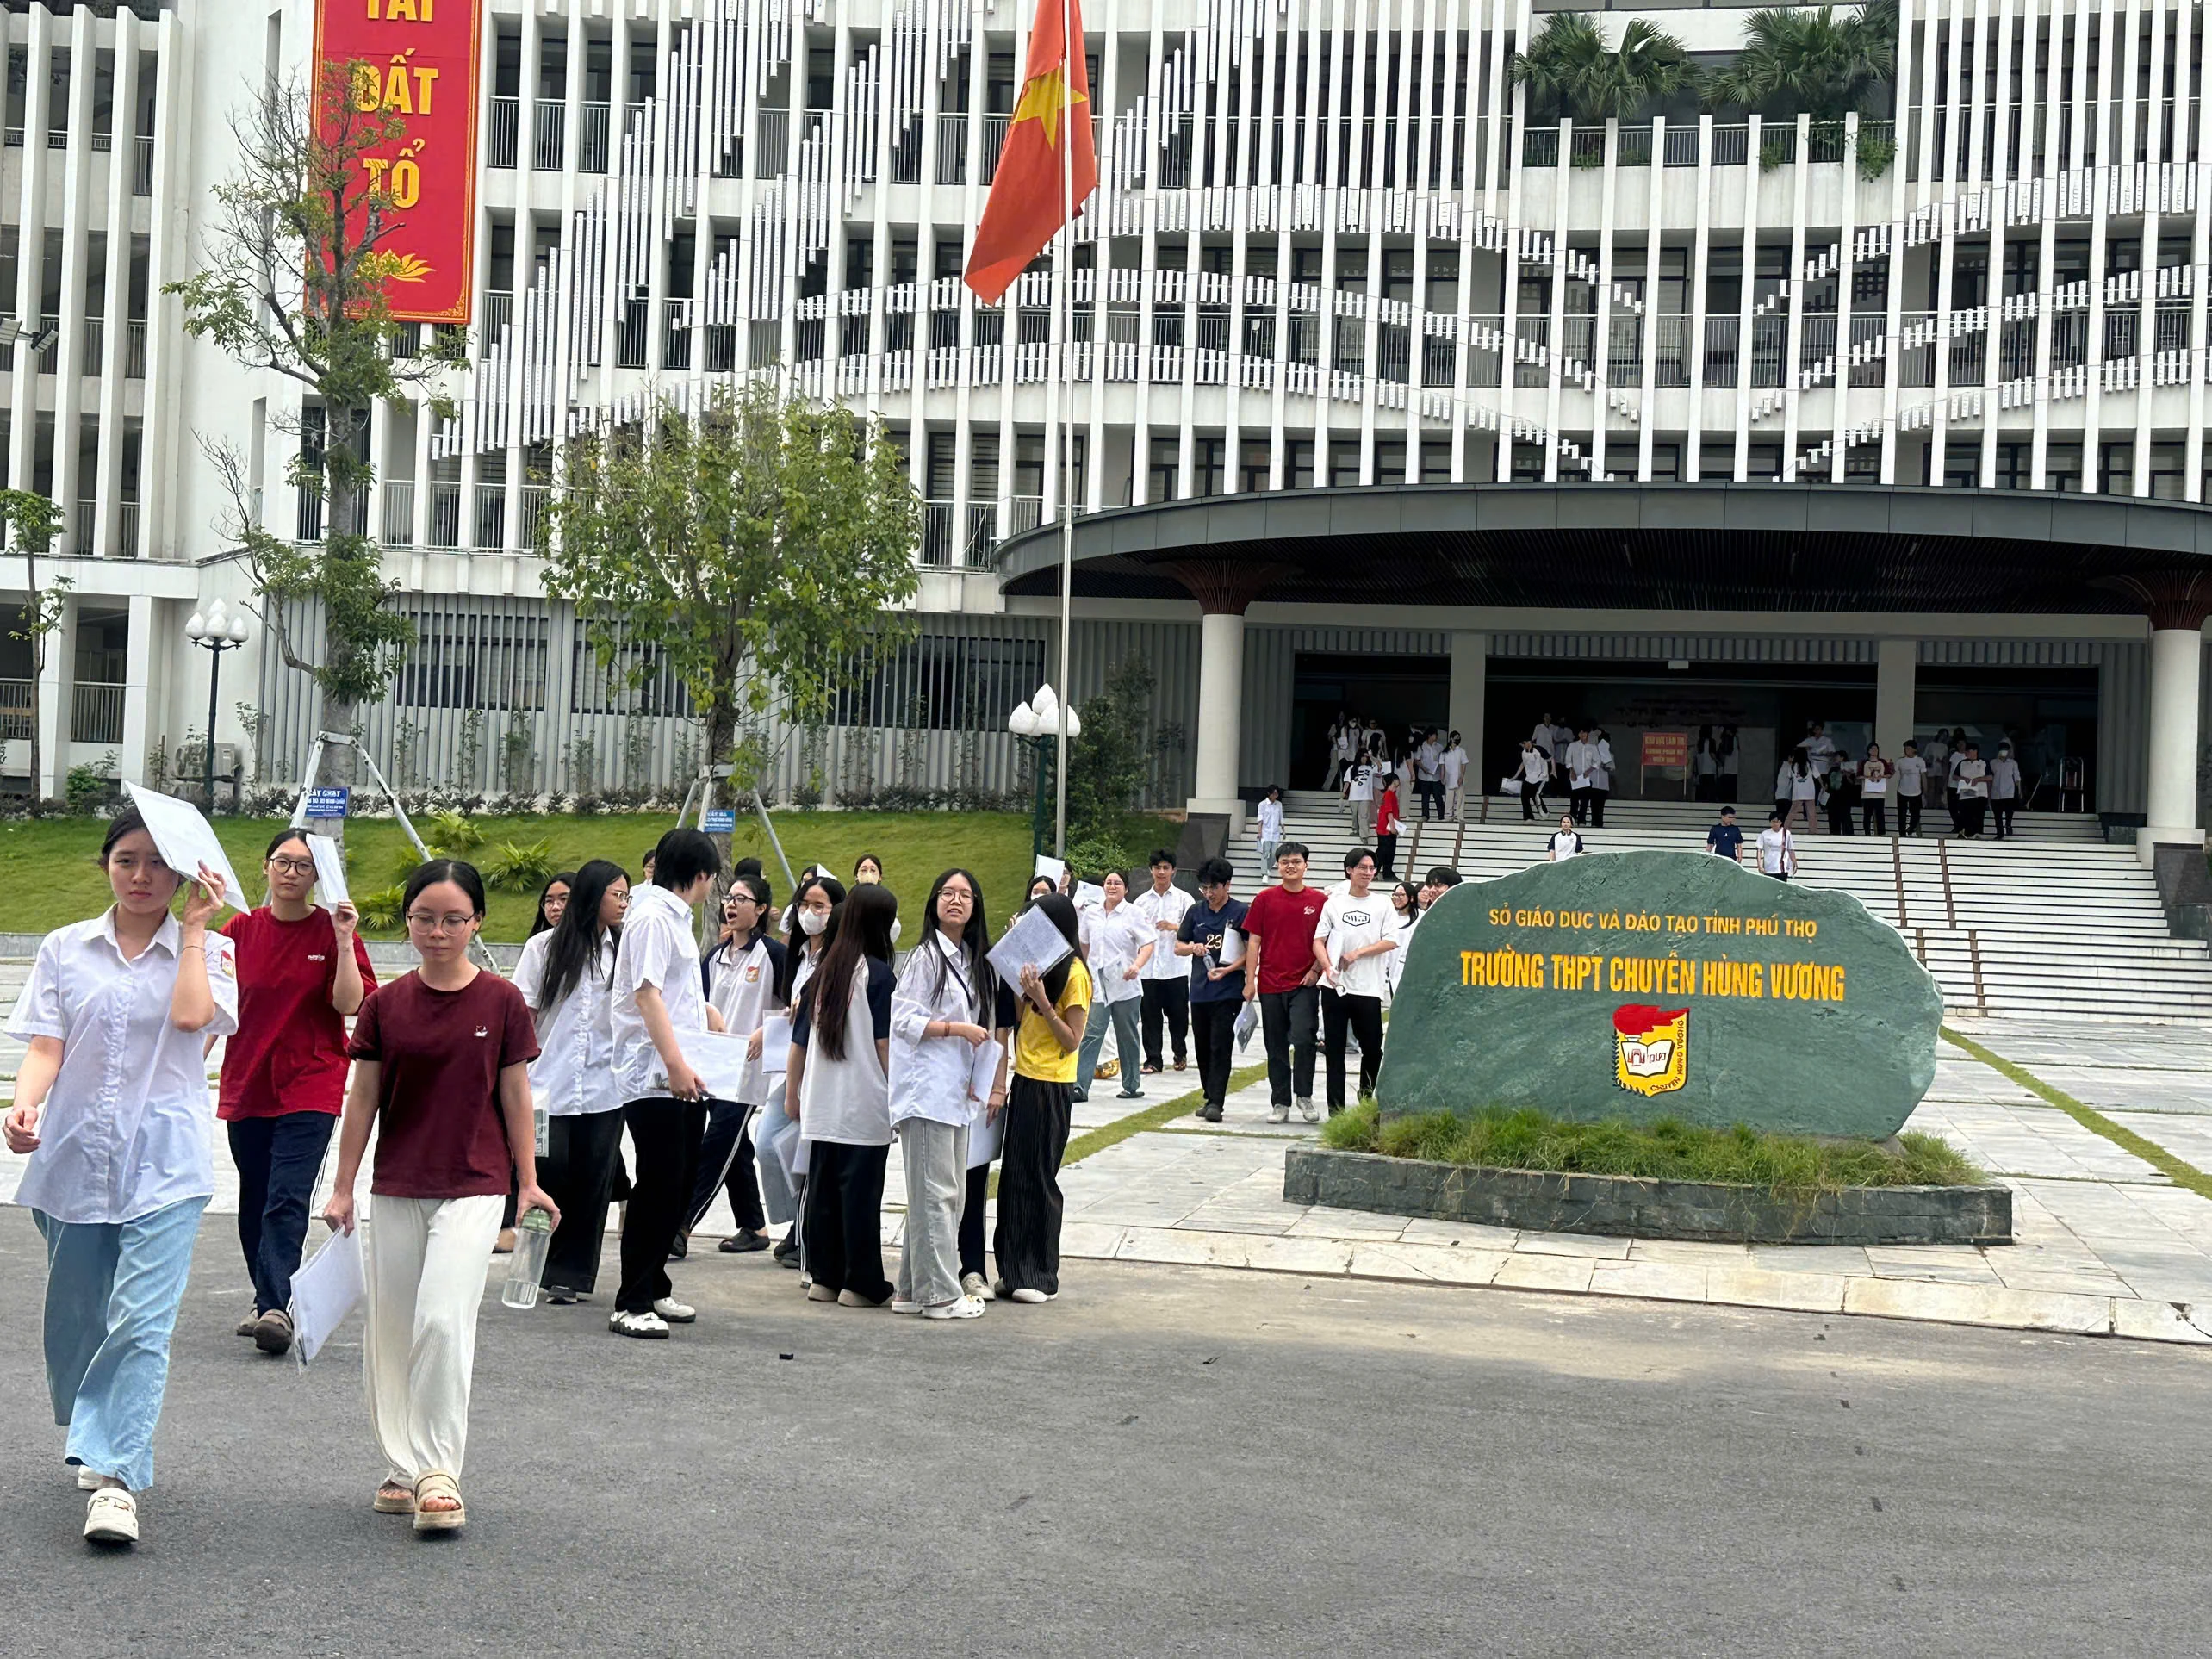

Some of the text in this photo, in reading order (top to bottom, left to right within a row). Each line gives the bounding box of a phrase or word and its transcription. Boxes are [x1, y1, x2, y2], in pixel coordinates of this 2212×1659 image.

[363, 138, 426, 208] TỔ
[1205, 934, 1222, 949] 23
[1515, 904, 1555, 928] GIÁO
[1560, 910, 1594, 935] DỤC
[1599, 908, 1620, 930] VÀ
[1665, 915, 1698, 938] TẠO
[1703, 909, 1741, 935] TỈNH
[1745, 913, 1779, 936] PHÚ
[1783, 919, 1817, 944] THỌ
[1460, 943, 1846, 1002] TRƯỜNG THPT CHUYÊN HÙNG VƯƠNG
